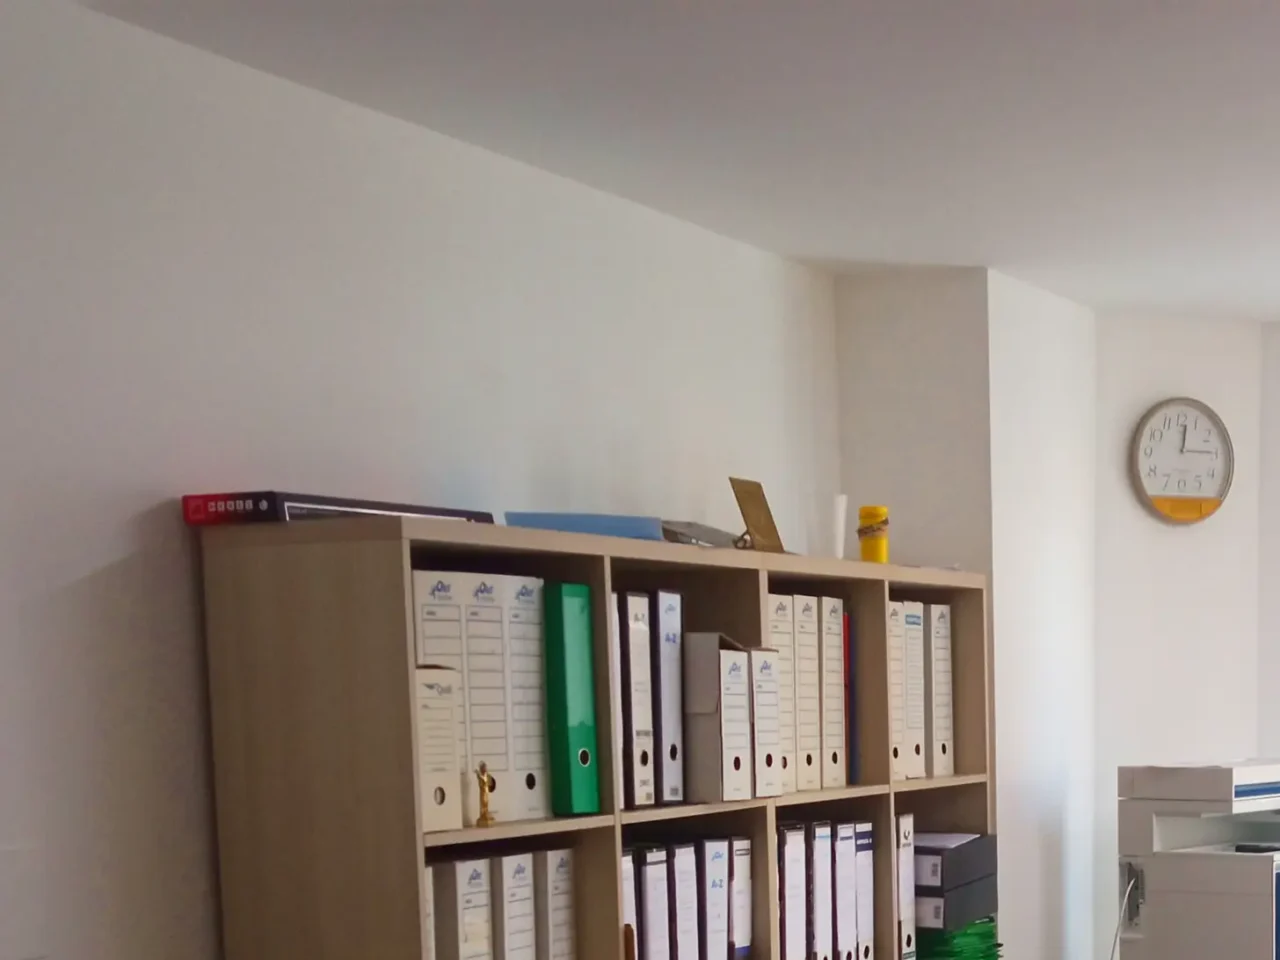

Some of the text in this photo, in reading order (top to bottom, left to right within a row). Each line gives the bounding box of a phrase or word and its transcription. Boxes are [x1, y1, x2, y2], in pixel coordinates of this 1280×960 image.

[1162, 413, 1172, 430] 11
[1149, 428, 1163, 442] 10
[1144, 446, 1153, 459] 9
[1147, 464, 1157, 478] 8
[1162, 473, 1172, 491] 7
[1193, 475, 1202, 491] 5
